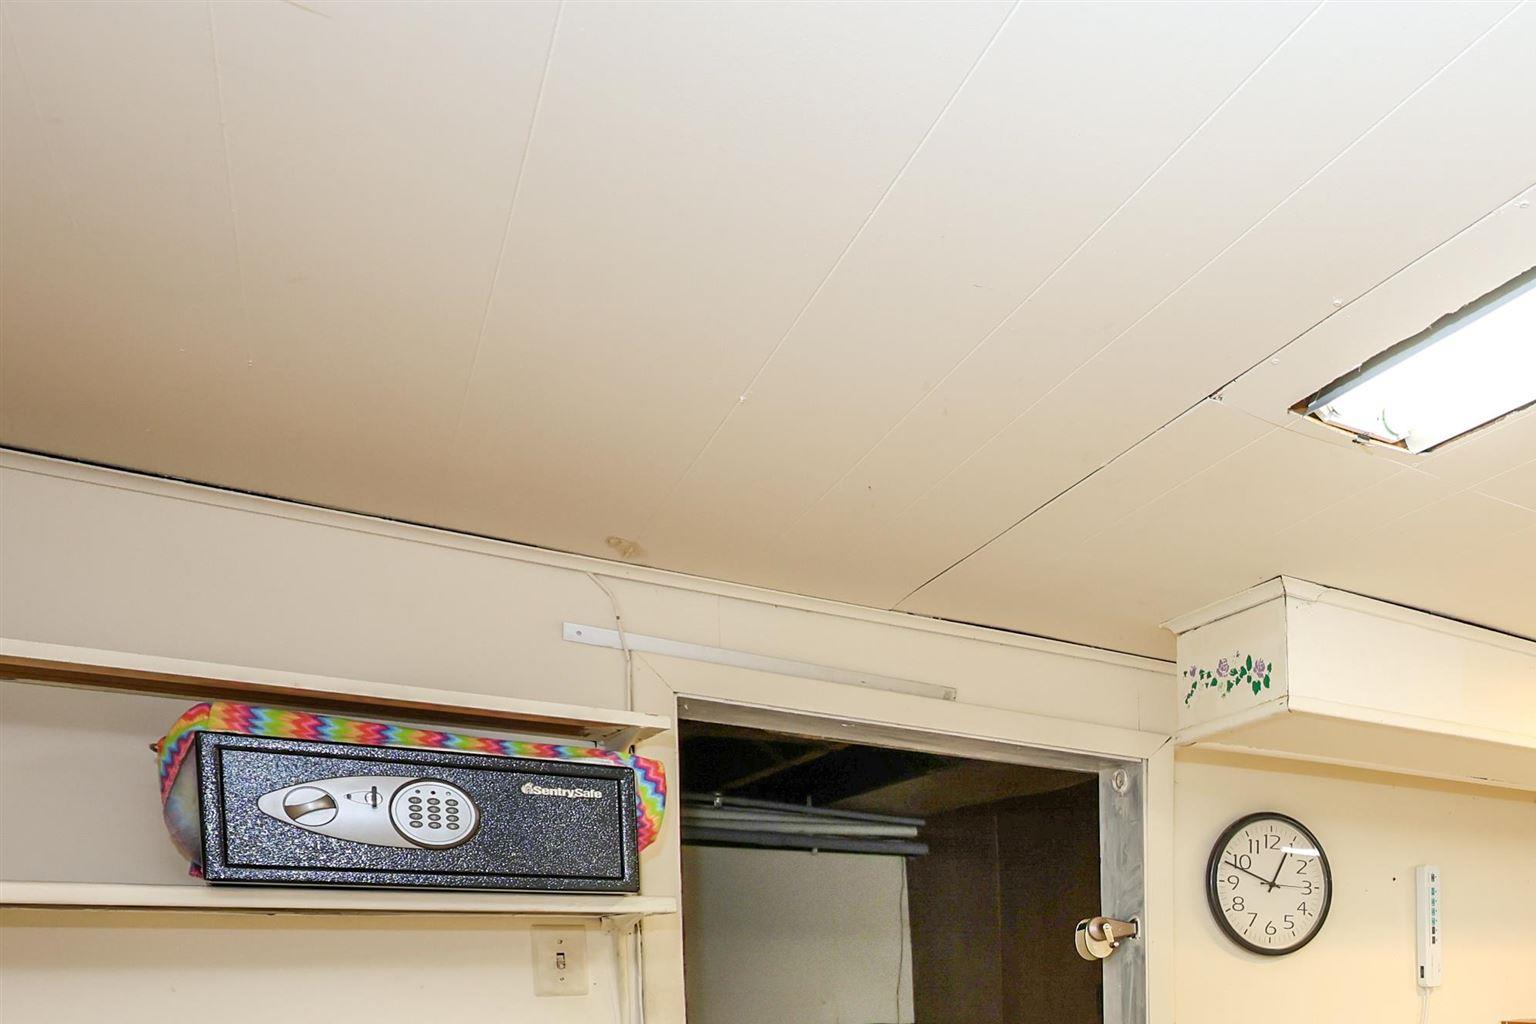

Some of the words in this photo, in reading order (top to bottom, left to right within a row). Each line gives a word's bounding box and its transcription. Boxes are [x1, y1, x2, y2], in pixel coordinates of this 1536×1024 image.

[533, 785, 603, 798] SentrySafe
[1248, 838, 1260, 854] 11
[1263, 834, 1281, 850] 12
[1233, 854, 1252, 870] 10
[1296, 860, 1307, 874] 2
[1227, 875, 1240, 890] 9
[1301, 880, 1312, 895] 3
[1232, 896, 1245, 912] 8
[1297, 902, 1308, 915] 4
[1248, 912, 1258, 927] 7
[1284, 915, 1294, 929] 5
[1265, 920, 1277, 935] 6
